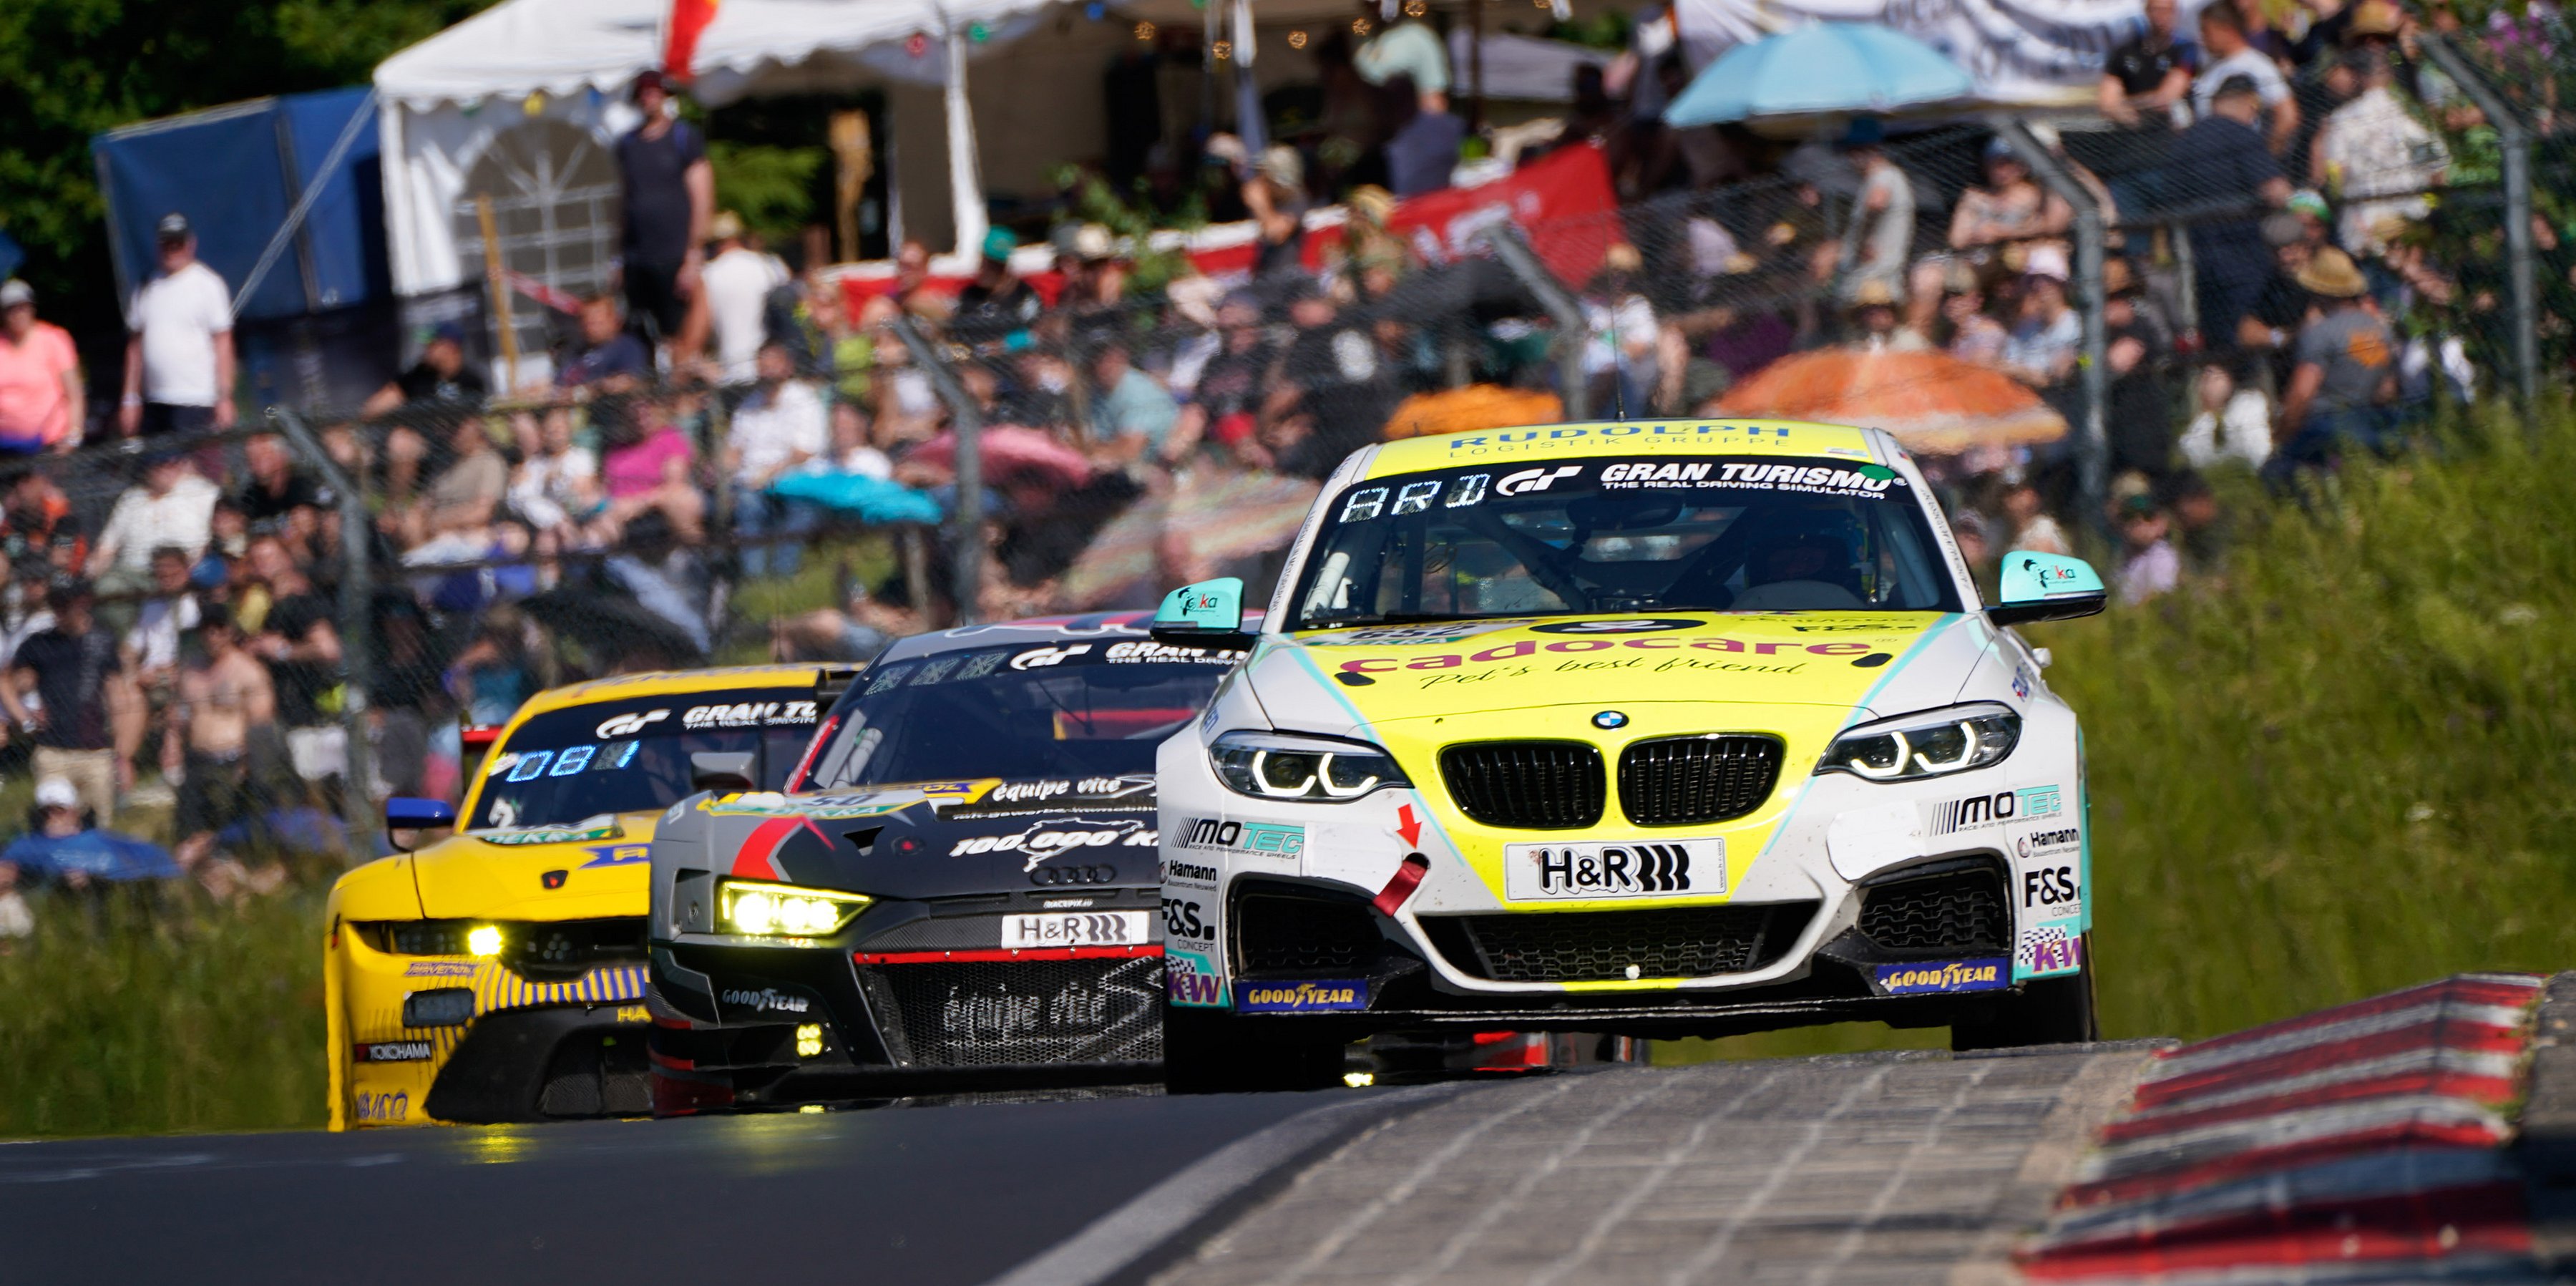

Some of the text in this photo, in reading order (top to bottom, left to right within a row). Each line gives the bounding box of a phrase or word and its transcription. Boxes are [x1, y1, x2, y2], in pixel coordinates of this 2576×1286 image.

[1449, 436, 1789, 458] LOGISTIK GRUPPE
[1450, 425, 1790, 448] RUDOLPH
[1600, 463, 1712, 482] GRAN
[1602, 482, 1639, 490] THE
[1703, 481, 1774, 490] DRIVING
[1781, 484, 1886, 500] SIMULATOR
[1340, 638, 1872, 673] cadocare
[1555, 657, 1643, 673] best
[1654, 657, 1807, 675] friend
[683, 702, 780, 723] GRAN
[683, 721, 715, 730] THE
[718, 718, 759, 727] REAL
[992, 776, 1122, 802] équipe vite
[2030, 828, 2079, 848] Hamann
[1169, 859, 1216, 881] Hamann
[1541, 848, 1632, 890] H&R
[1020, 917, 1080, 941] H&R
[1178, 940, 1214, 952] CONCEPT
[1167, 973, 1221, 1005] KW
[369, 1043, 431, 1060] YOKOHAMA
